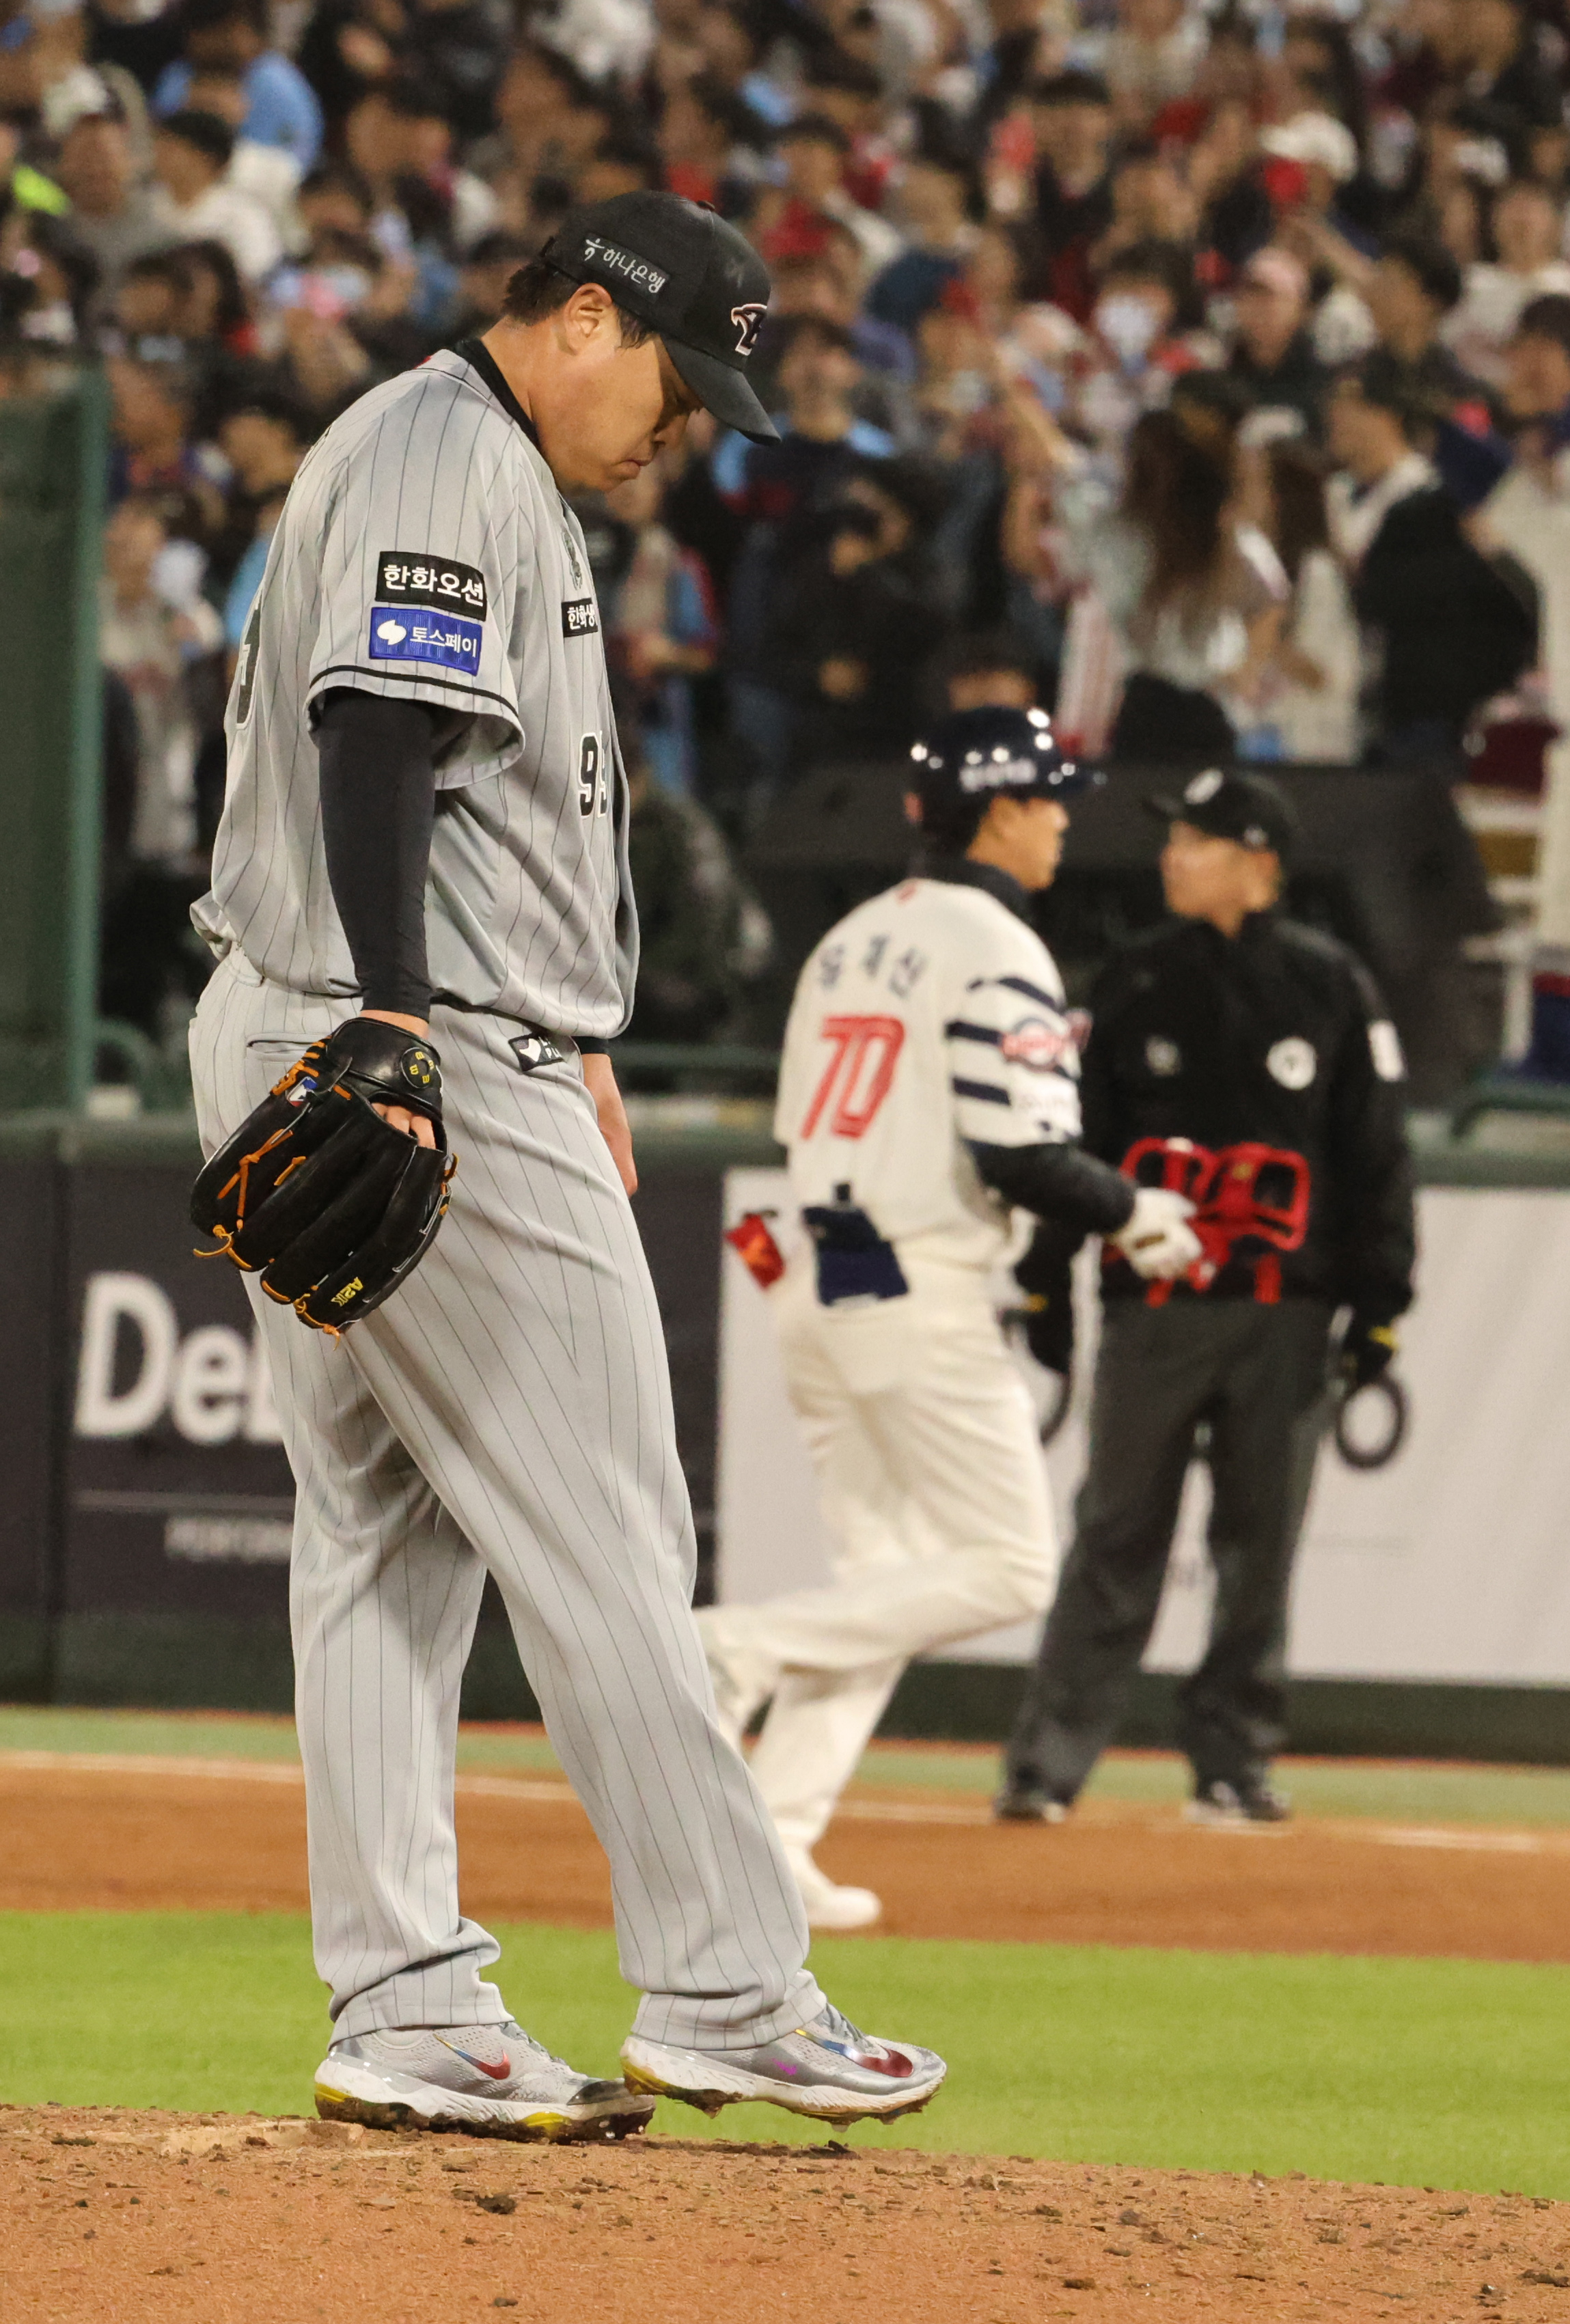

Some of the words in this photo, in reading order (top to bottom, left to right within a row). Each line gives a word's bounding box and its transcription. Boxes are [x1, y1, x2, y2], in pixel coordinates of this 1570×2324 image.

[603, 249, 665, 293] 하나은행
[384, 565, 484, 607] 한화오션
[567, 604, 597, 630] 한화생
[410, 628, 478, 658] 토스페이
[800, 1015, 904, 1140] 70
[331, 1276, 363, 1307] A2K
